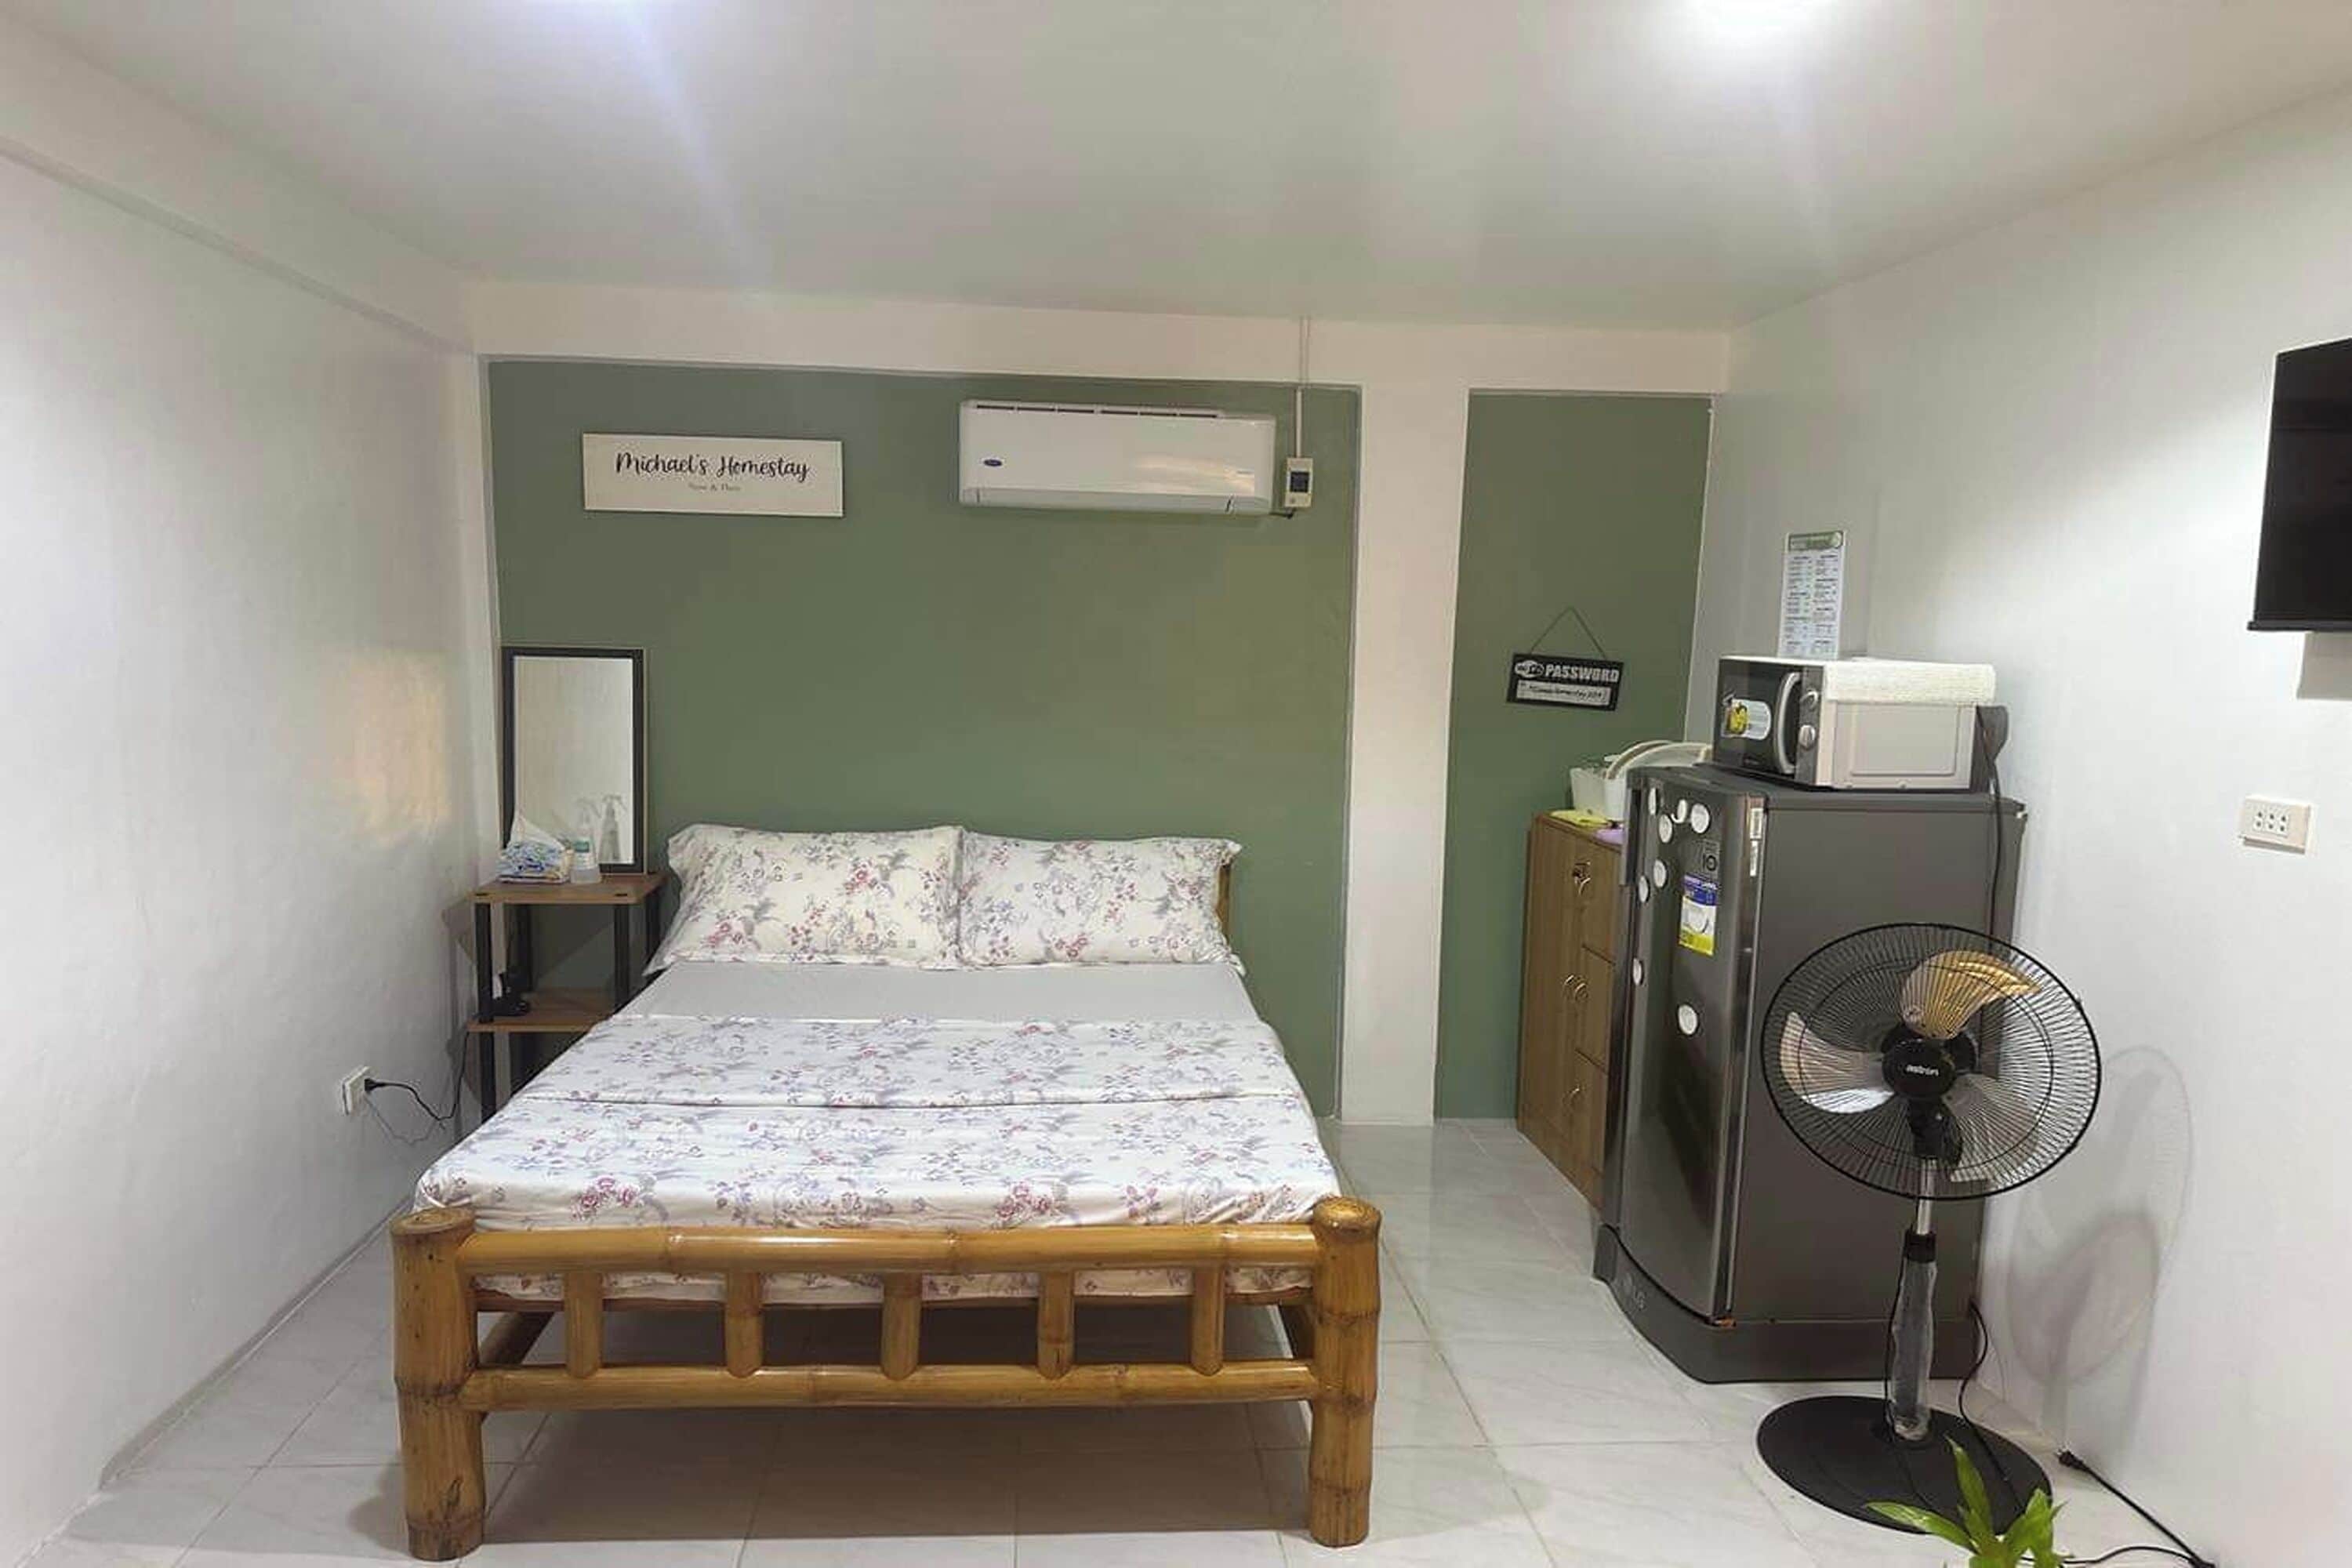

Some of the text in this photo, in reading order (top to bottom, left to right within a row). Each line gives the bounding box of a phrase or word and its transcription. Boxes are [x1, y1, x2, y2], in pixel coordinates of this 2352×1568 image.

[616, 452, 809, 483] Michael's Homestay
[1544, 664, 1620, 683] PASSWORD
